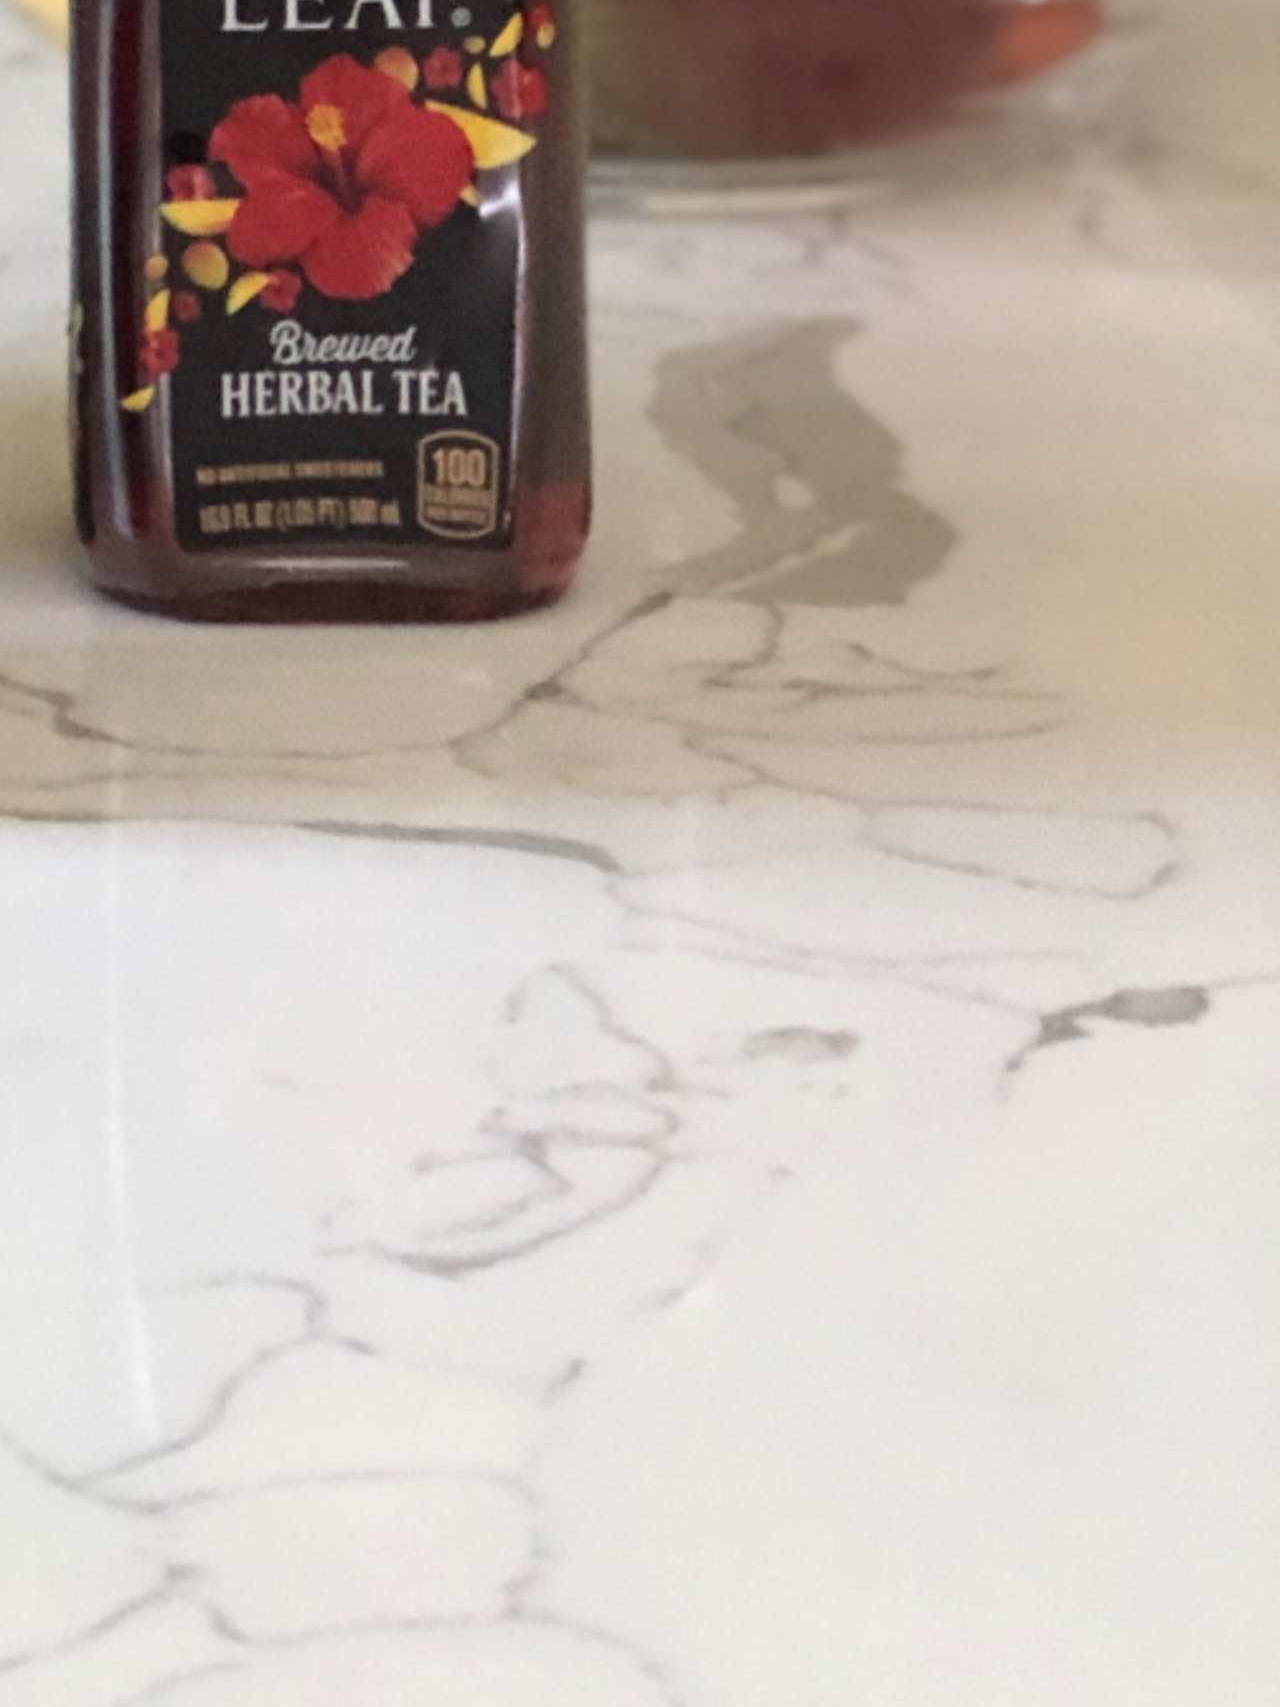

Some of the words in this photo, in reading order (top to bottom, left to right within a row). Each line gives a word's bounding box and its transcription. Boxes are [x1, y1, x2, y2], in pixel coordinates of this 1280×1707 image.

[269, 319, 418, 365] Brewed
[220, 370, 383, 419] HERBAL
[392, 370, 468, 417] TEA
[432, 448, 486, 487] 100
